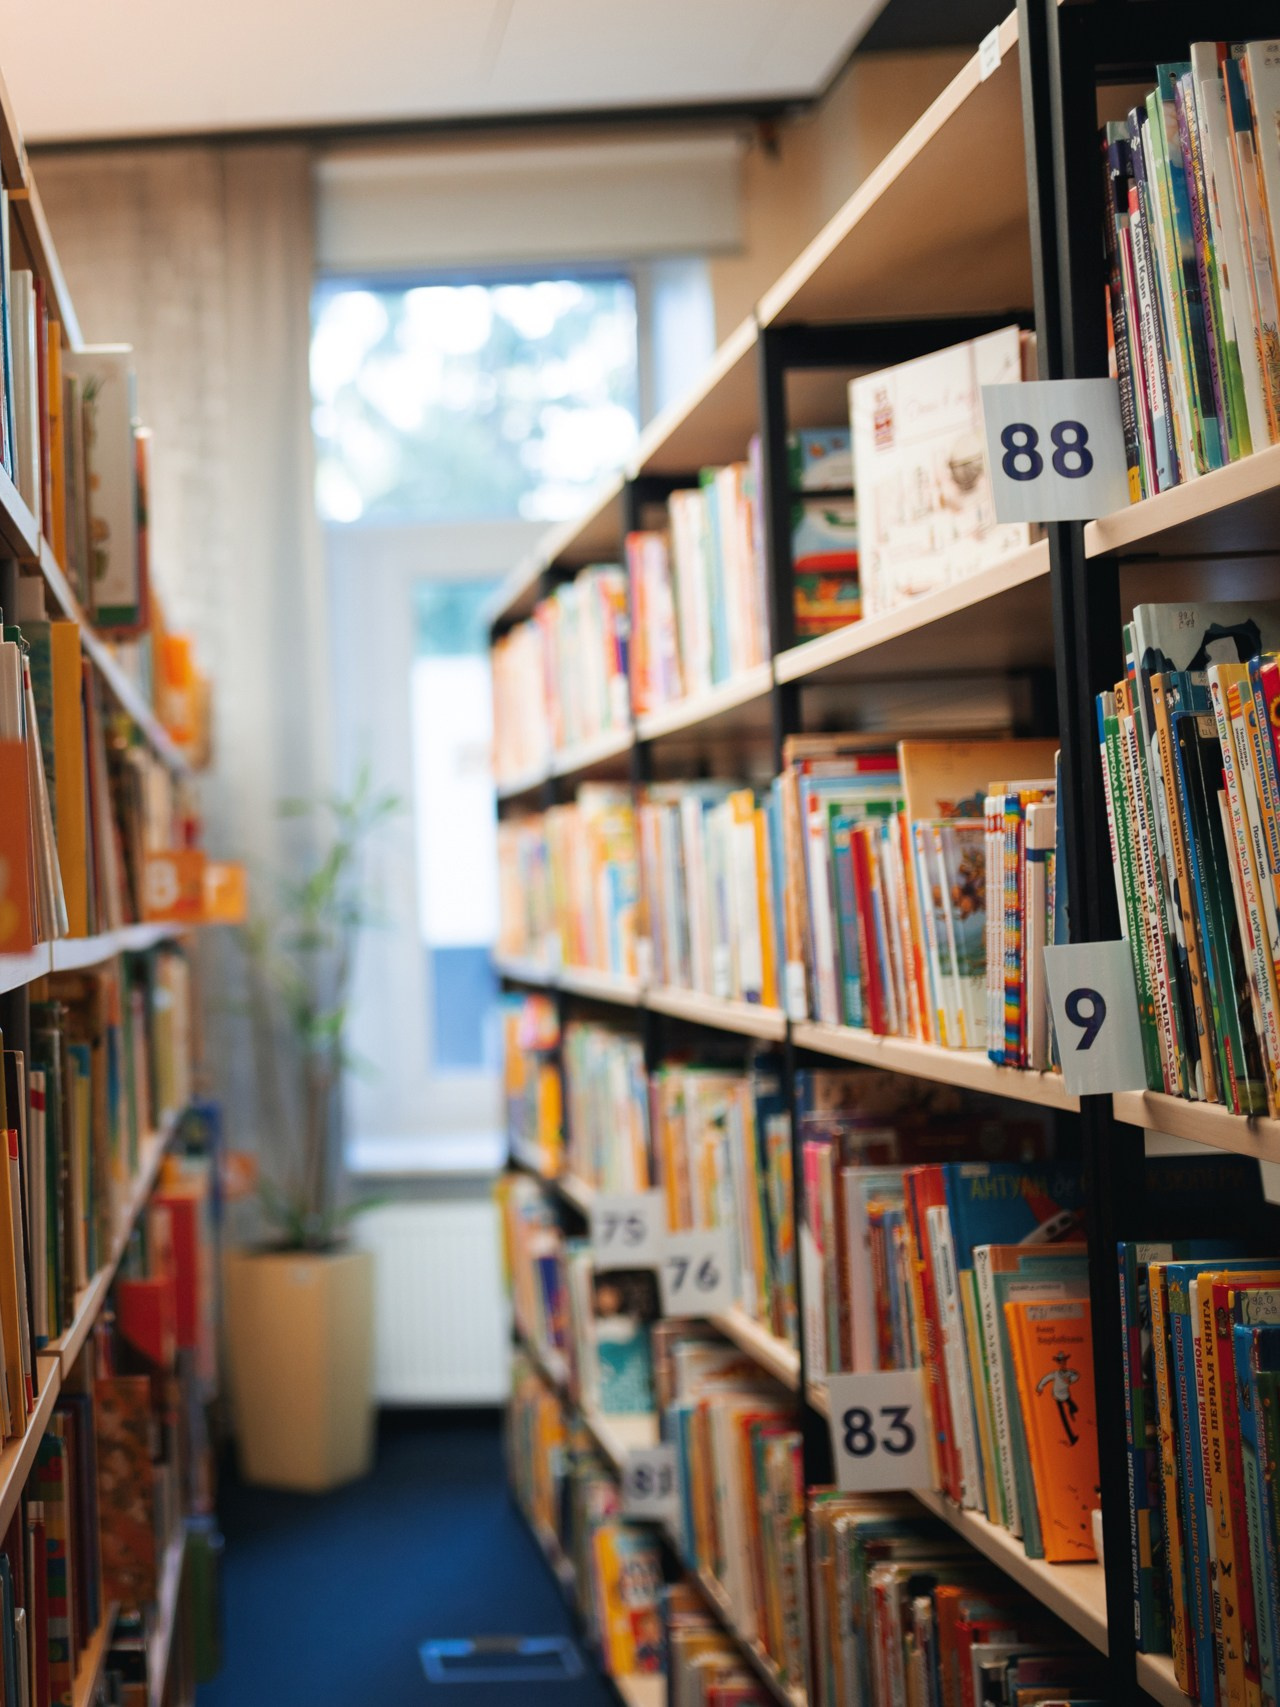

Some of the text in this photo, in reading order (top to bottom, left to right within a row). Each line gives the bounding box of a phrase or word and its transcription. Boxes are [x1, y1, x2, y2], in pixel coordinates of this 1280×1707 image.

[1134, 222, 1144, 264] Харви
[1138, 266, 1147, 299] Карп
[1142, 236, 1155, 291] улучшения
[1158, 353, 1166, 392] памяти
[1163, 401, 1173, 451] внимания
[1144, 303, 1153, 342] Самый
[1149, 344, 1160, 412] счастливый
[1000, 420, 1095, 481] 88
[1217, 709, 1236, 789] ЛЮБОЗНАШЕК
[1160, 728, 1183, 877] Мамина помощница
[1231, 794, 1237, 803] И
[1107, 734, 1119, 789] ПРИРОДА
[1115, 799, 1132, 898] ЗАНИМАТЕЛЬНЫХ
[1127, 899, 1144, 994] ЭКСПЕРИМЕНТАХ
[1115, 733, 1126, 788] ПРИРОДА
[1123, 799, 1141, 898] ЗАНИМАТЕЛЬНЫХ
[1137, 899, 1153, 996] ЭКСПЕРИМЕНТАХ
[1139, 756, 1151, 800] АТЛАС
[1148, 808, 1159, 877] ПРИРОДА
[1156, 880, 1168, 934] РОССИИ
[1234, 808, 1249, 876] ПОЧЕМУЧЕК
[1253, 825, 1266, 880] Познай мир
[1129, 728, 1147, 830] ЭНЦИКЛОПЕДИЯ
[1142, 834, 1154, 888] ЗНАНИЙ
[1152, 923, 1163, 974] ТИНЫ
[1159, 979, 1177, 1085] КАНДЕЛАКИ
[1247, 881, 1256, 903] ДЛЯ
[1251, 909, 1271, 1002] ЭНЦИКЛОПЕДИЯ
[1064, 988, 1107, 1050] 9
[969, 1172, 1047, 1201] АНТУАН
[597, 1210, 646, 1247] 75
[668, 1256, 721, 1293] 76
[1174, 1316, 1185, 1373] ПОЛНАЯ
[1194, 1336, 1205, 1398] ПЕРИОД
[1203, 1298, 1222, 1473] МОЯ ПЕРВАЯ КНИГА
[841, 1405, 917, 1459] 83
[1179, 1375, 1194, 1488] ЭНЦИКЛОПЕДИЯ
[1199, 1401, 1213, 1508] ЛЕДНИКОВЫЙ
[1127, 1451, 1137, 1547] ЭНЦИКЛОПЕДИЯ
[1189, 1491, 1200, 1563] МЛАДШЕГО
[1194, 1565, 1205, 1640] ШКОЛЬНИКА
[1213, 1589, 1221, 1630] ПОЧЕМУ
[1217, 1640, 1226, 1675] ЗАЧЕМ
